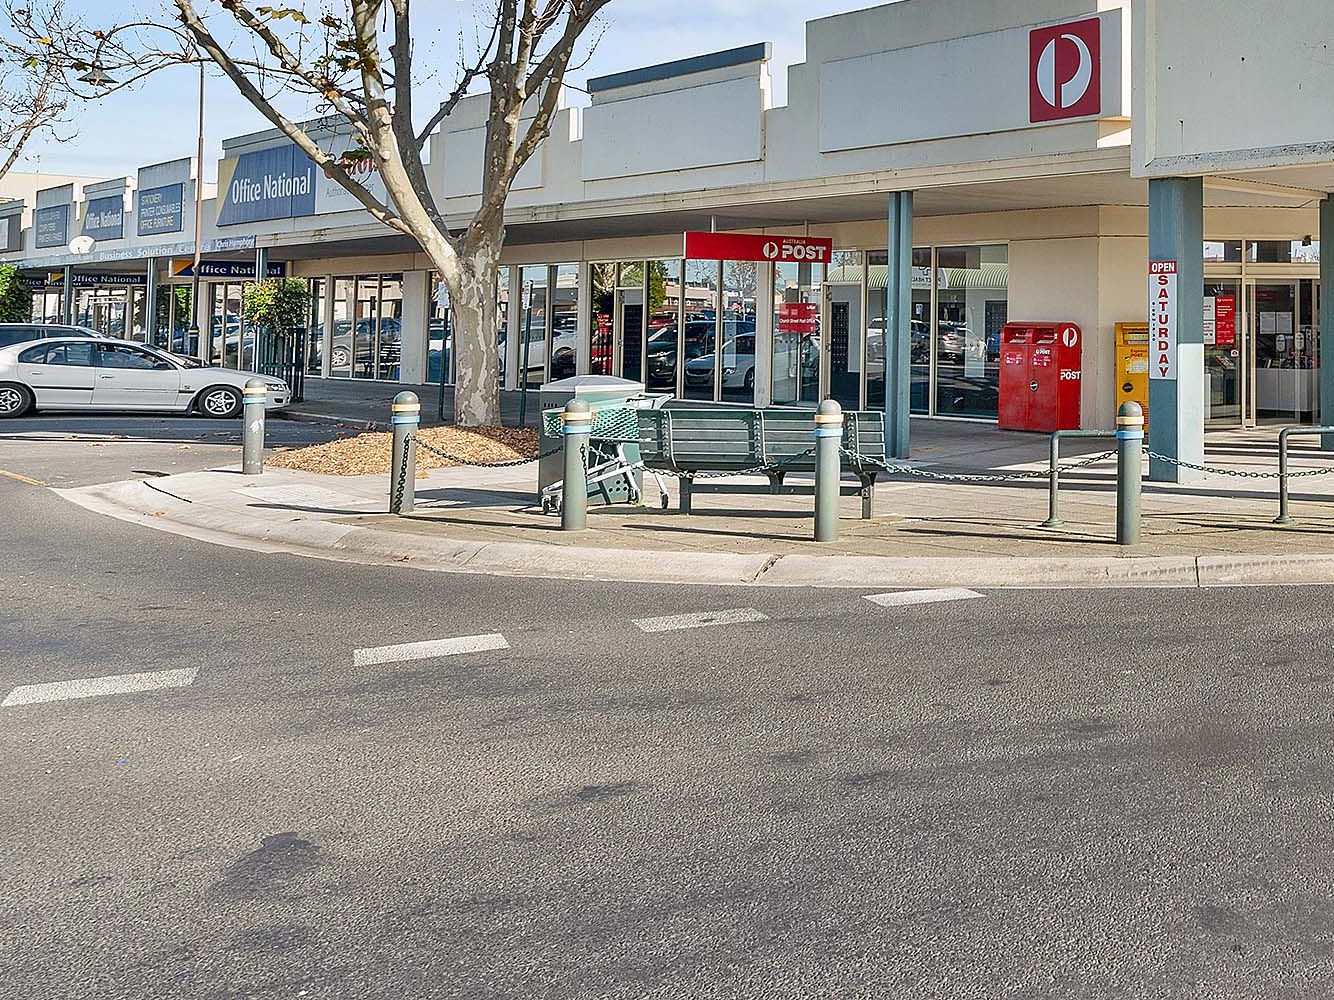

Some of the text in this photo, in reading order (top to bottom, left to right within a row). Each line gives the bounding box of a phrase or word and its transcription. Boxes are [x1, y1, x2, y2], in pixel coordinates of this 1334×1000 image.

[232, 178, 261, 205] Office
[263, 167, 311, 200] National
[86, 207, 122, 230] Office National
[100, 250, 133, 261] Business
[138, 244, 174, 258] Solution
[781, 244, 827, 260] POST
[230, 266, 281, 275] Natial
[1151, 262, 1175, 273] OPEN
[100, 274, 142, 284] National
[1157, 274, 1169, 378] SATURDAY
[1060, 370, 1082, 381] POST
